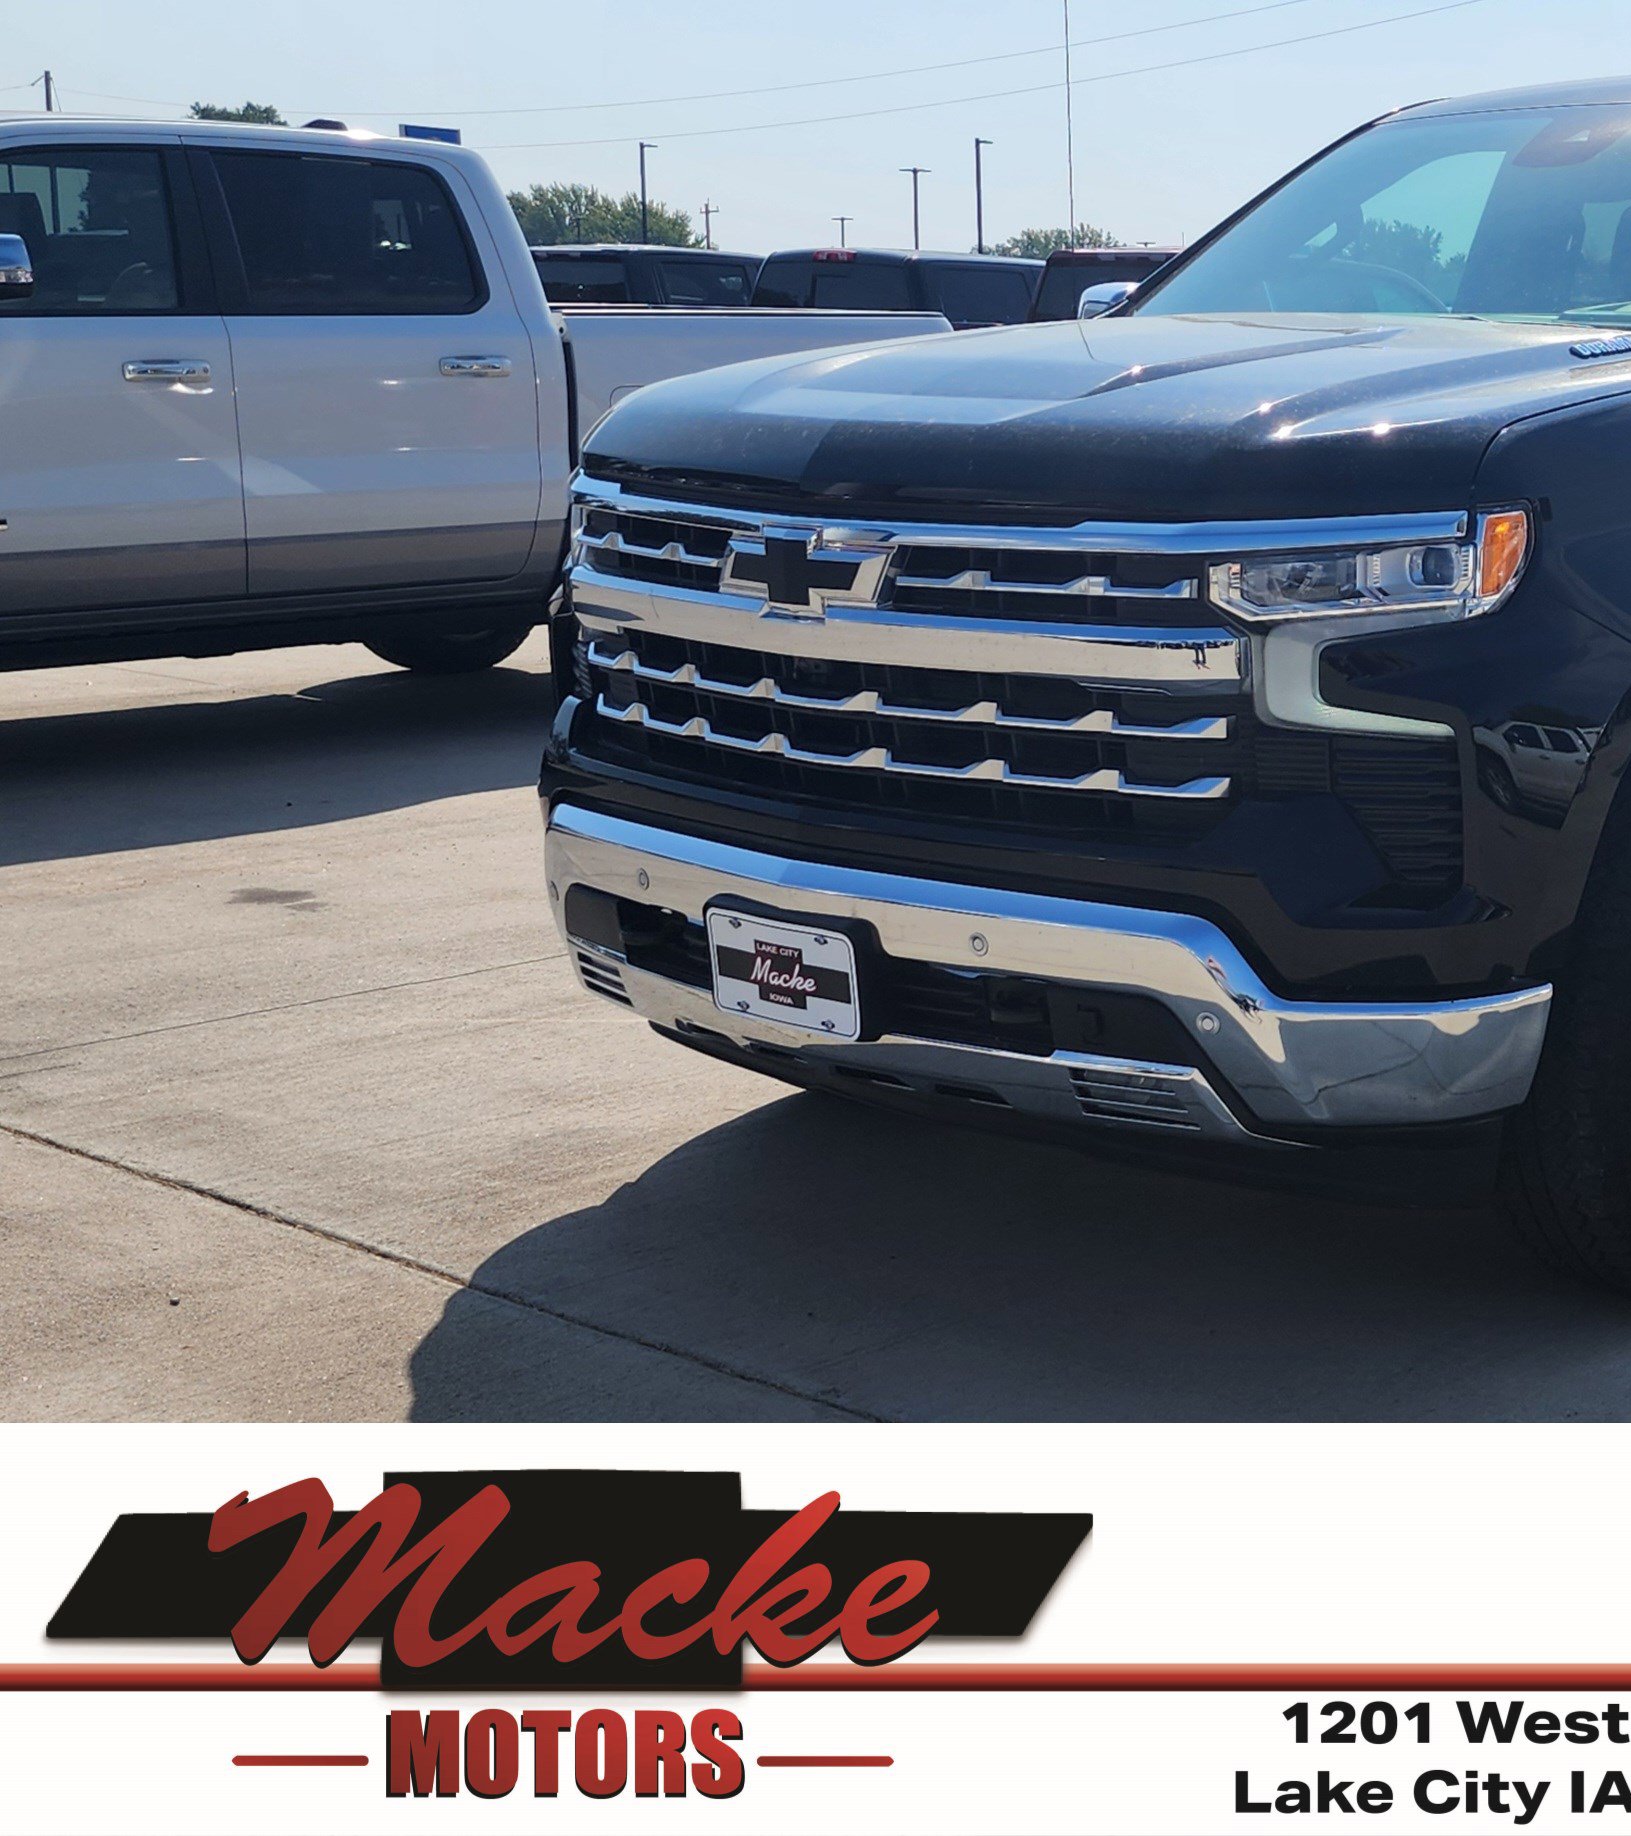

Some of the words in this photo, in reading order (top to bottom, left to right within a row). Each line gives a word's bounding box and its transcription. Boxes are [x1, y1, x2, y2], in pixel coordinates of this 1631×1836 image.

[757, 943, 778, 955] LAKE
[779, 947, 800, 957] CITY
[750, 956, 818, 992] Macke
[769, 993, 794, 1005] IOWA
